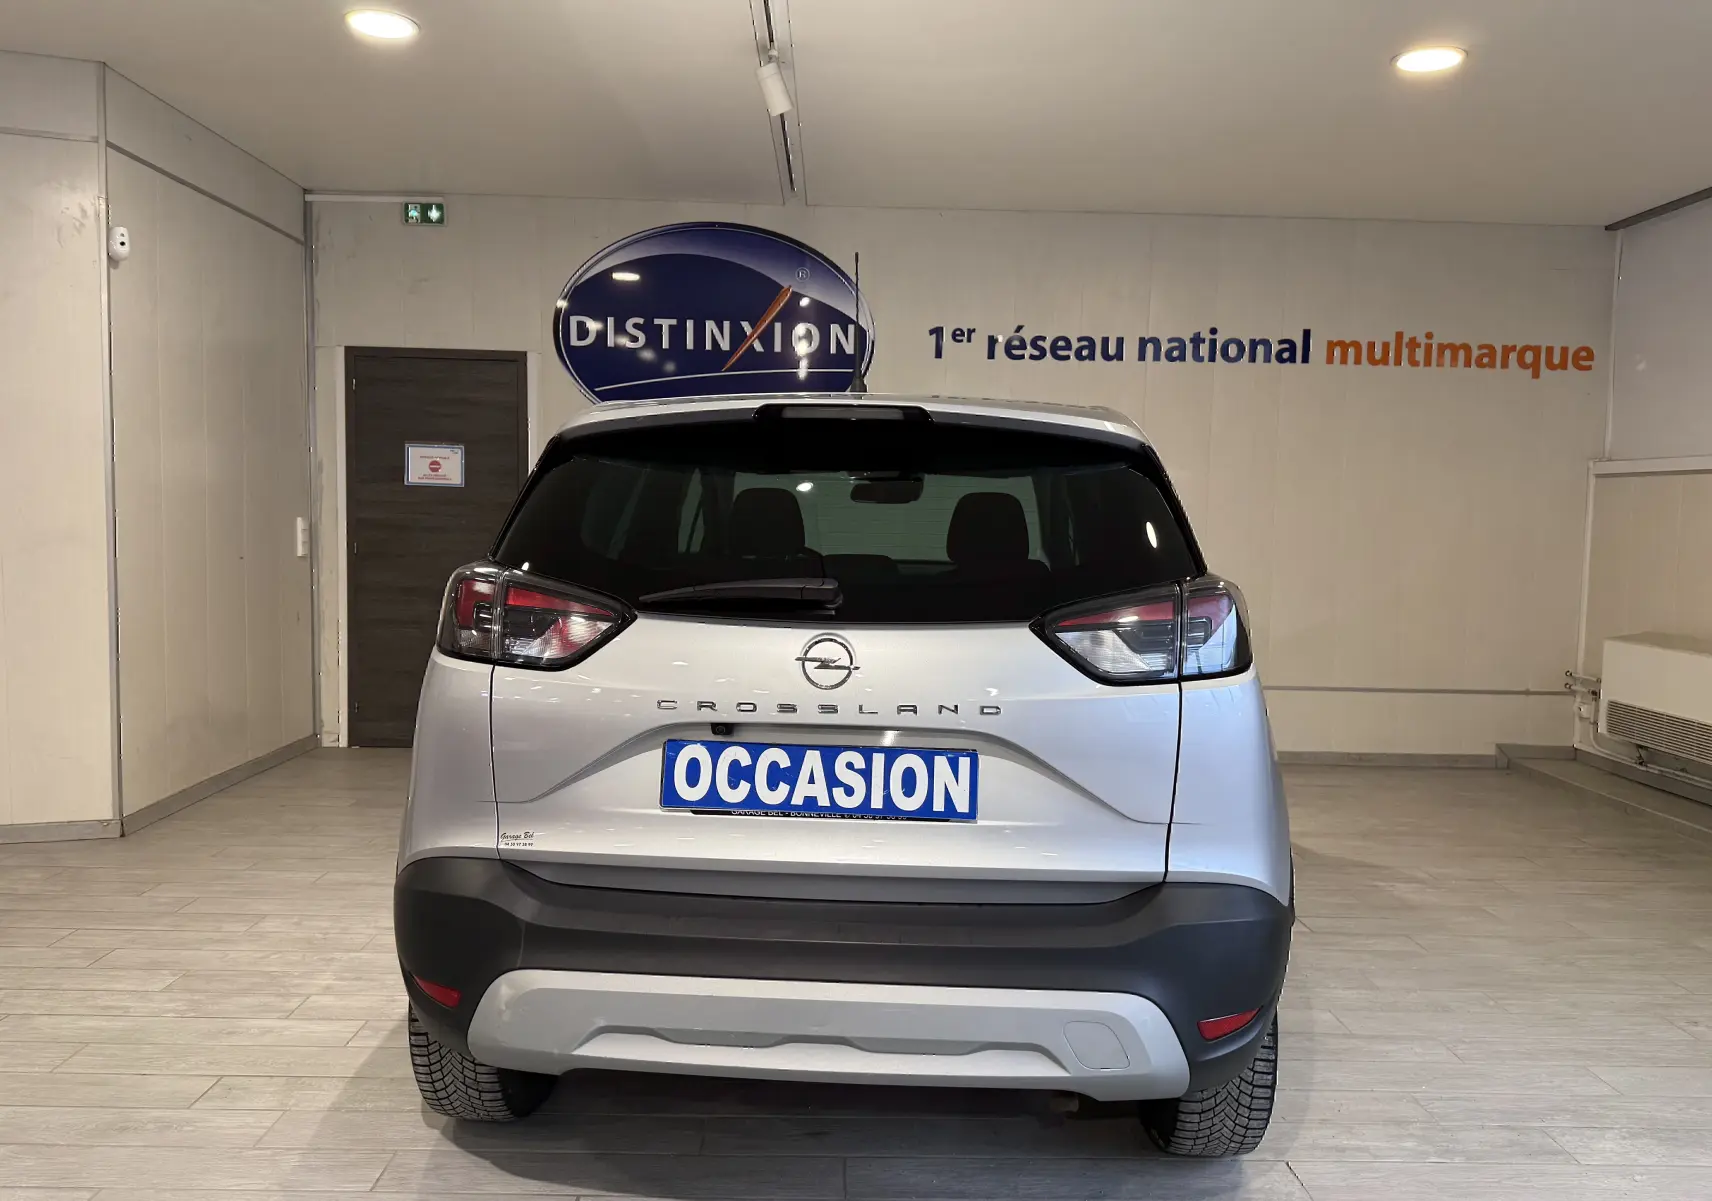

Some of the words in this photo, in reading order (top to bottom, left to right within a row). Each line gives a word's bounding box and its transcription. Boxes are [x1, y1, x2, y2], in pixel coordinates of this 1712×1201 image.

[928, 326, 976, 359] 1er
[987, 325, 1125, 362] réseau
[1137, 327, 1312, 364] national
[1325, 331, 1595, 379] multimarque
[656, 700, 1002, 716] CROSSLAND
[673, 744, 971, 814] OCCASION
